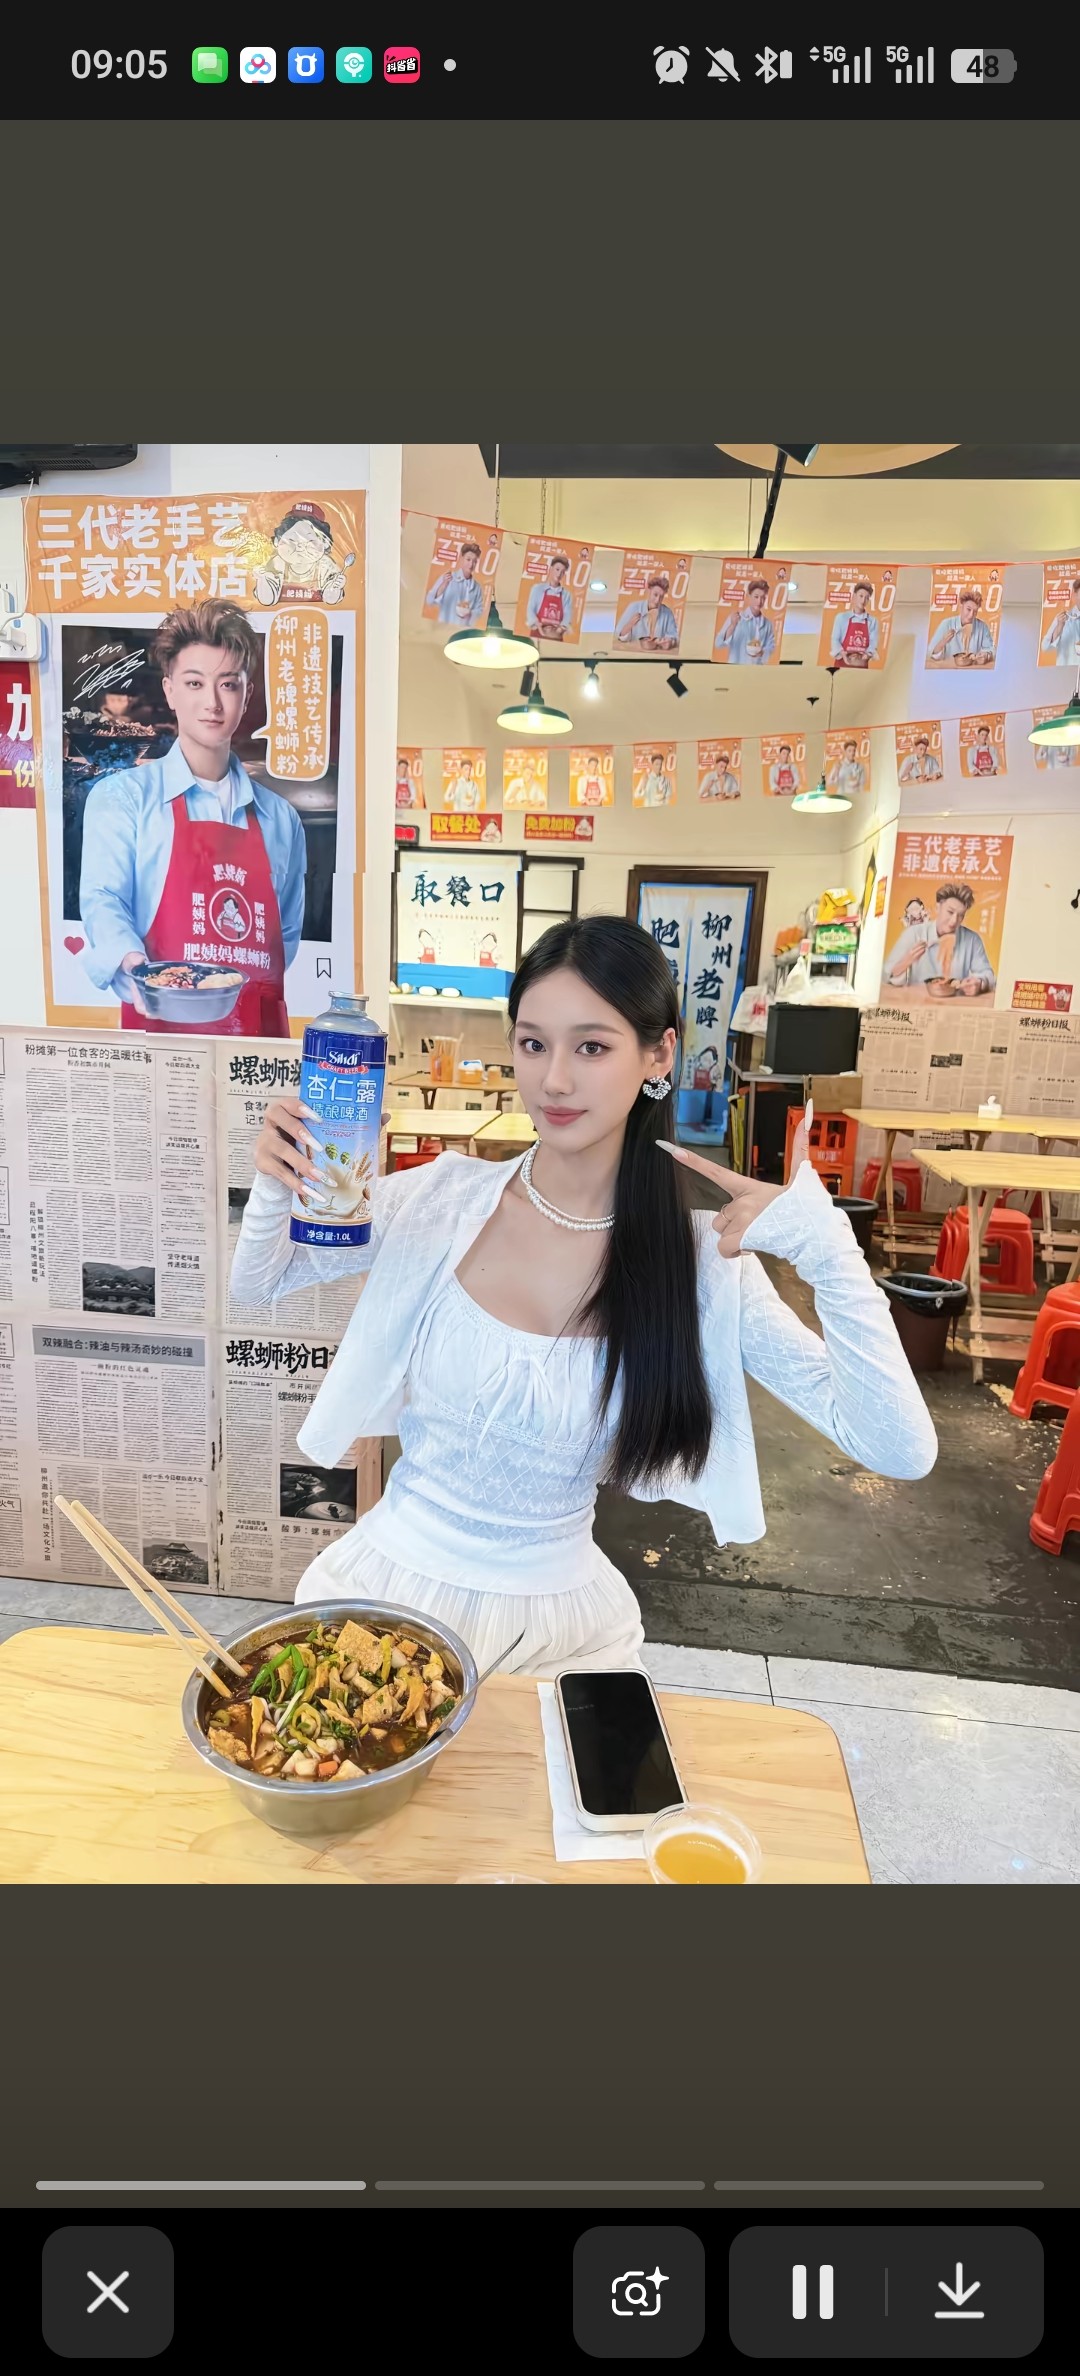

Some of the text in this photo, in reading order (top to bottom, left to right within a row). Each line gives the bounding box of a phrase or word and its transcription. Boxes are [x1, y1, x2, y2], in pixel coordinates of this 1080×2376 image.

[38, 503, 251, 549] 三代老手艺
[38, 555, 250, 600] 千家实体店
[274, 615, 301, 774] 柳州老牌螺蛳粉
[303, 624, 324, 770] 非遗技艺传承
[902, 853, 999, 875] 非遗传承人
[904, 835, 1002, 856] 三代老手艺
[411, 871, 505, 907] 取餐口
[192, 892, 206, 936] 肥姨妈
[183, 942, 271, 970] 肥姨妈螺蛳粉
[692, 911, 732, 1030] 柳州老牌
[307, 1074, 377, 1104] 杏仁露
[313, 1102, 369, 1121] 精酿啤酒
